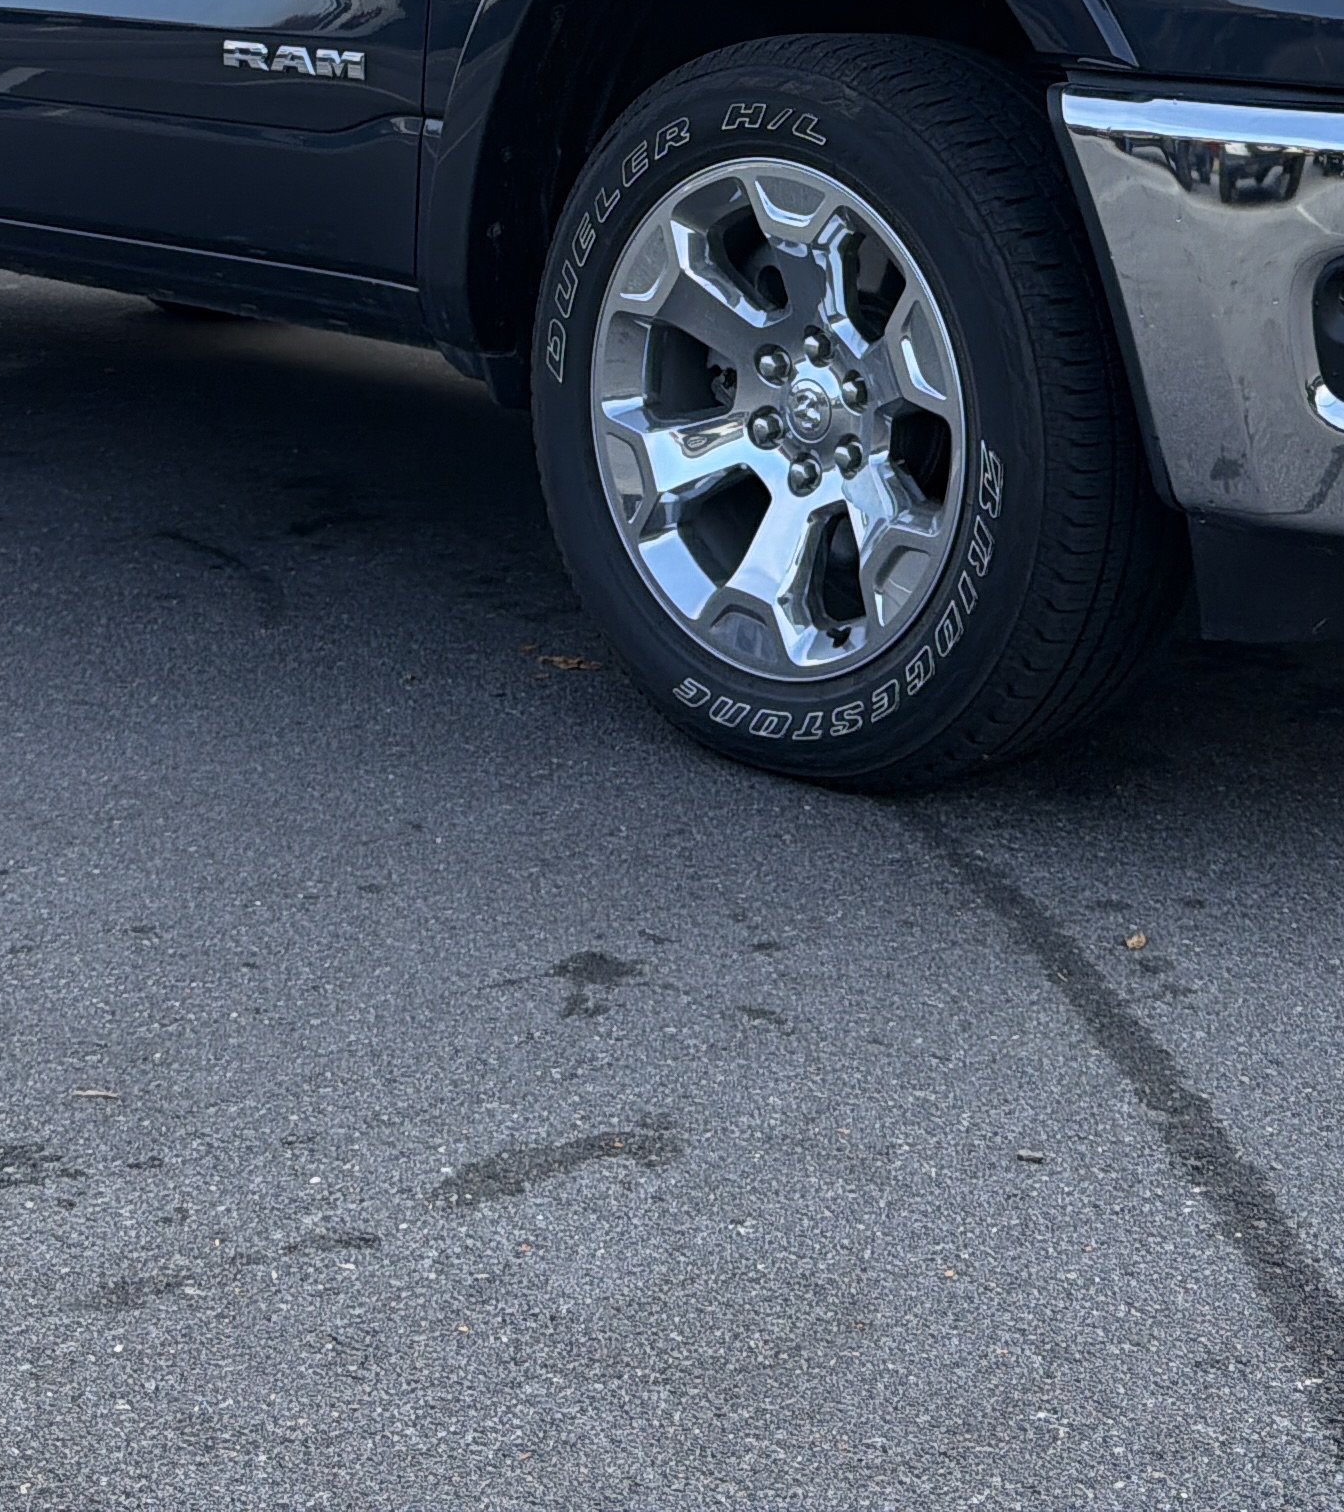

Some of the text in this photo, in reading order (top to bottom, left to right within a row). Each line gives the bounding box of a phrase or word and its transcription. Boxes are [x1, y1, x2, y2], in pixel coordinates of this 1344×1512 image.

[223, 39, 366, 81] RAM
[546, 102, 827, 384] DUELER H/L
[672, 439, 1004, 741] BRIDGESTONE
